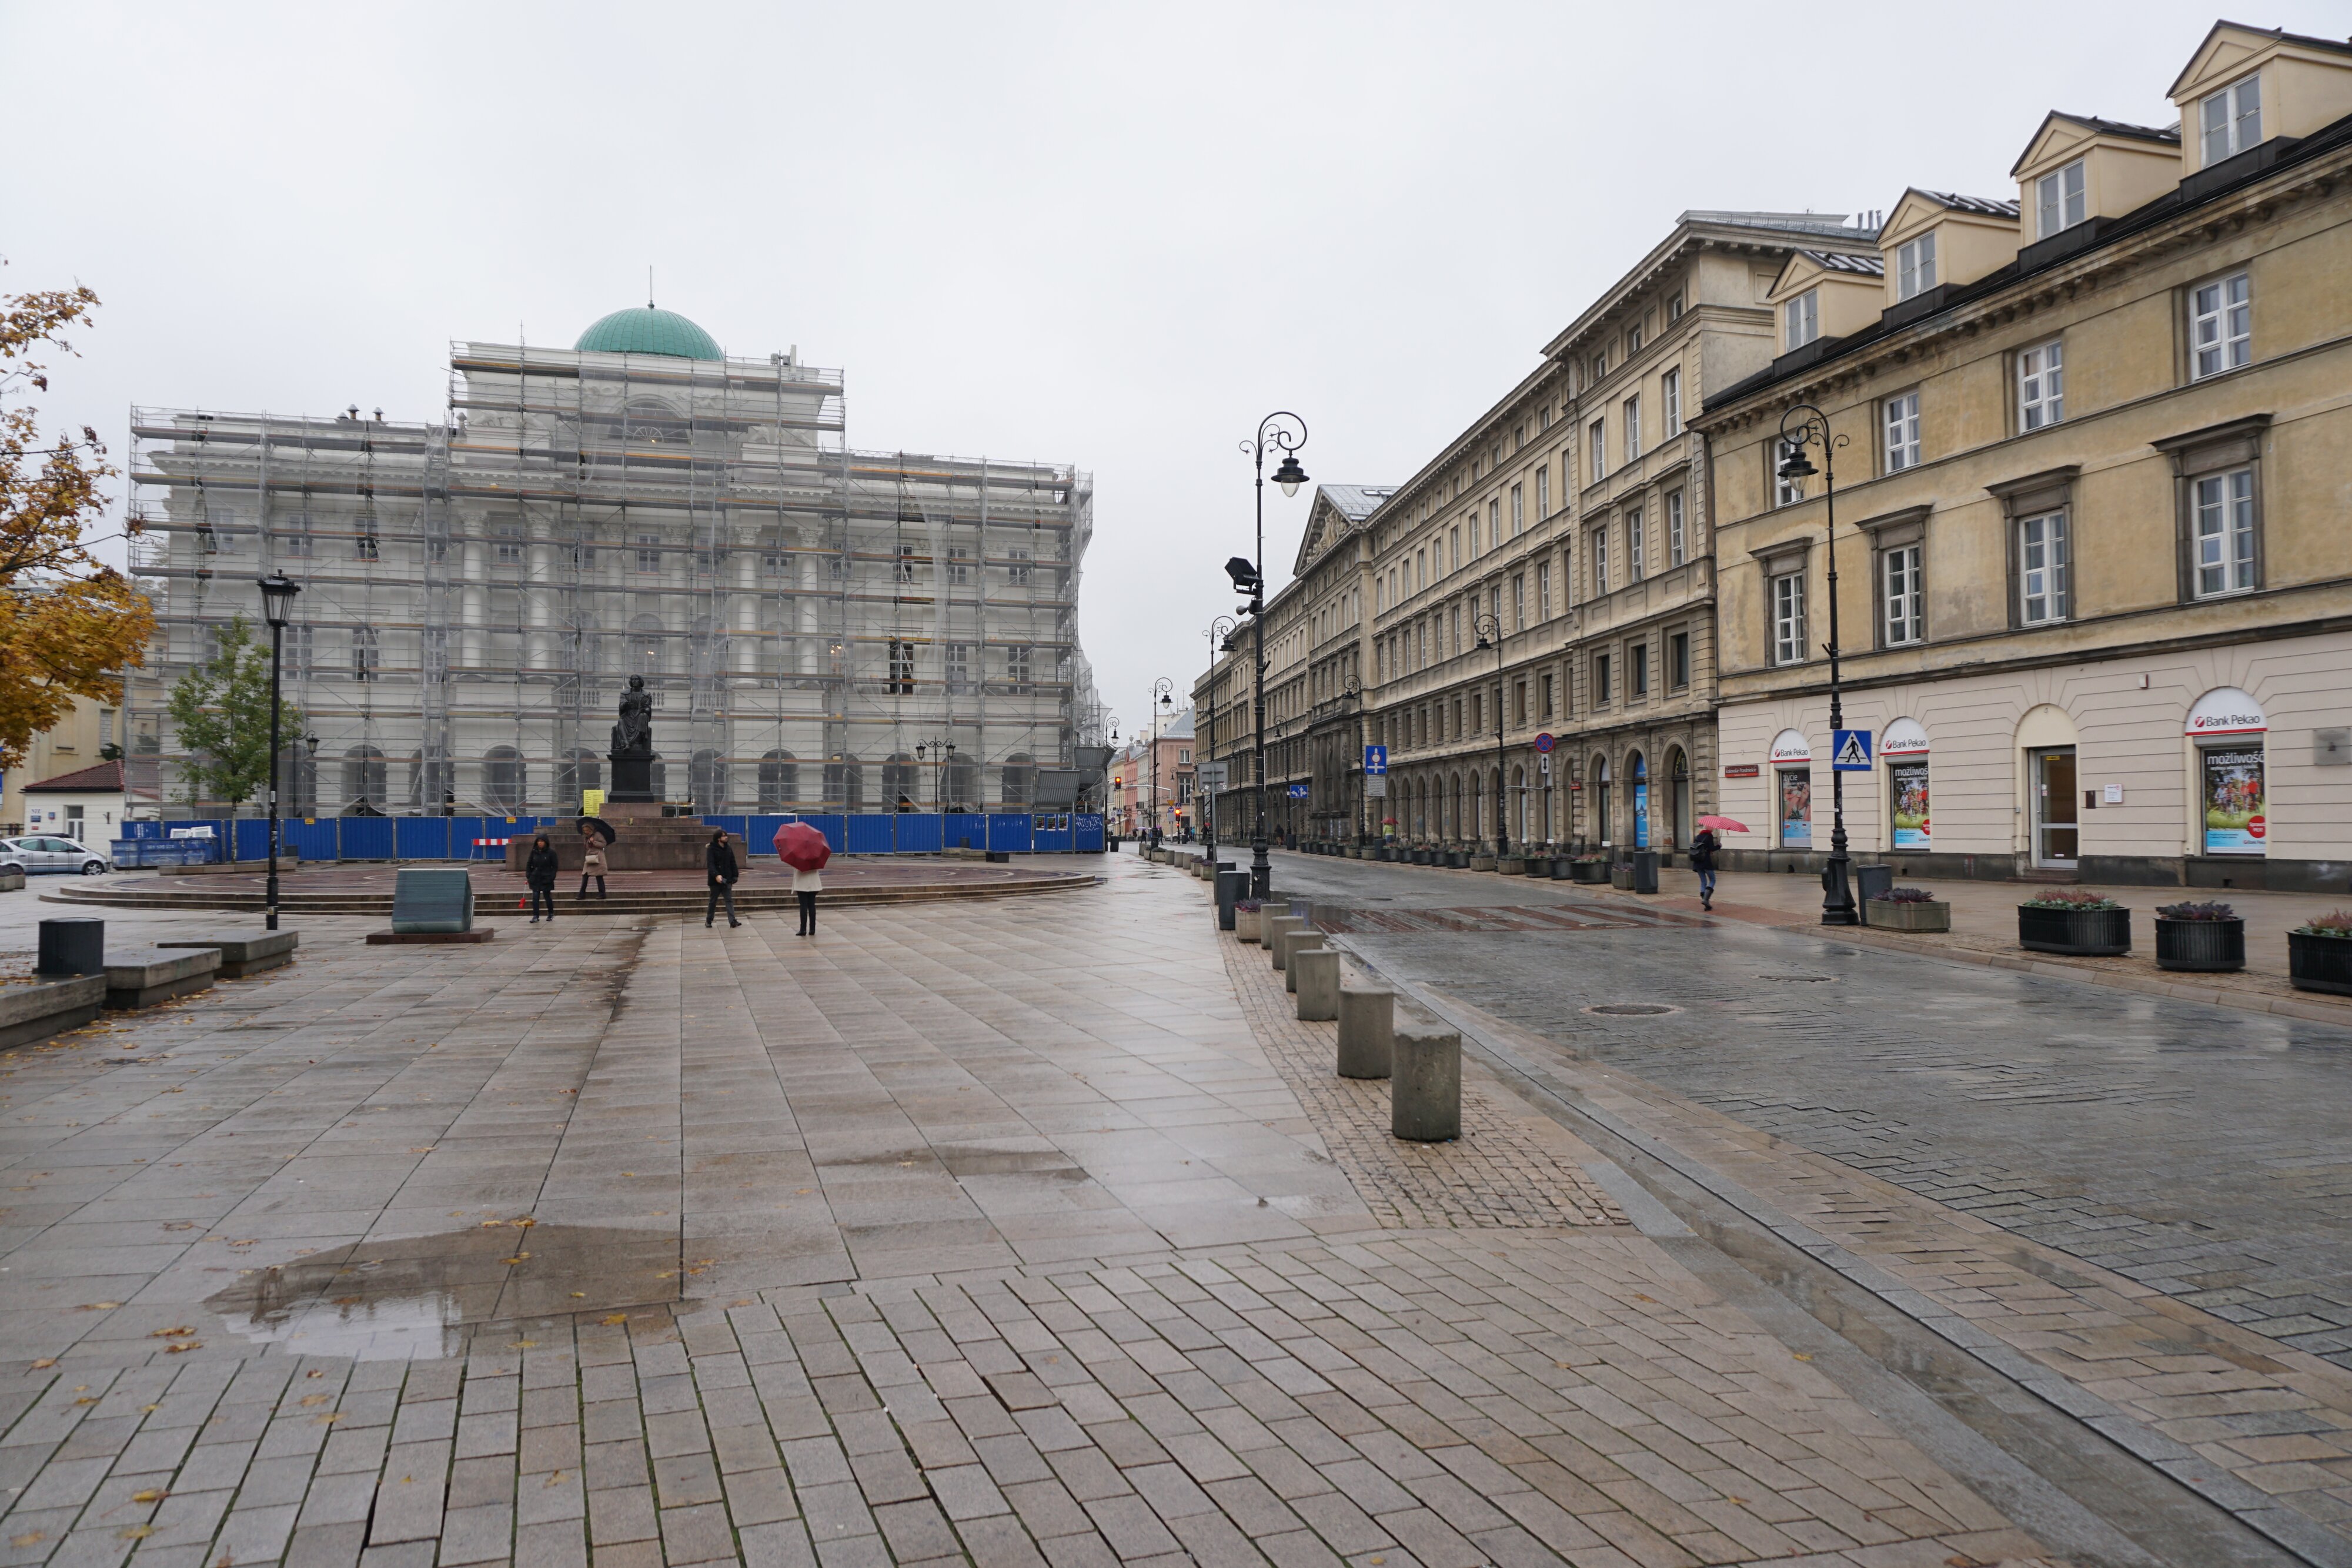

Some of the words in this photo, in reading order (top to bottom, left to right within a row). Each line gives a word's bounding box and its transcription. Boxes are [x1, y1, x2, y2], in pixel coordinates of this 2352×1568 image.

[2206, 716, 2229, 726] Bank
[2231, 714, 2260, 724] Pekao
[1893, 740, 1907, 748] Bank
